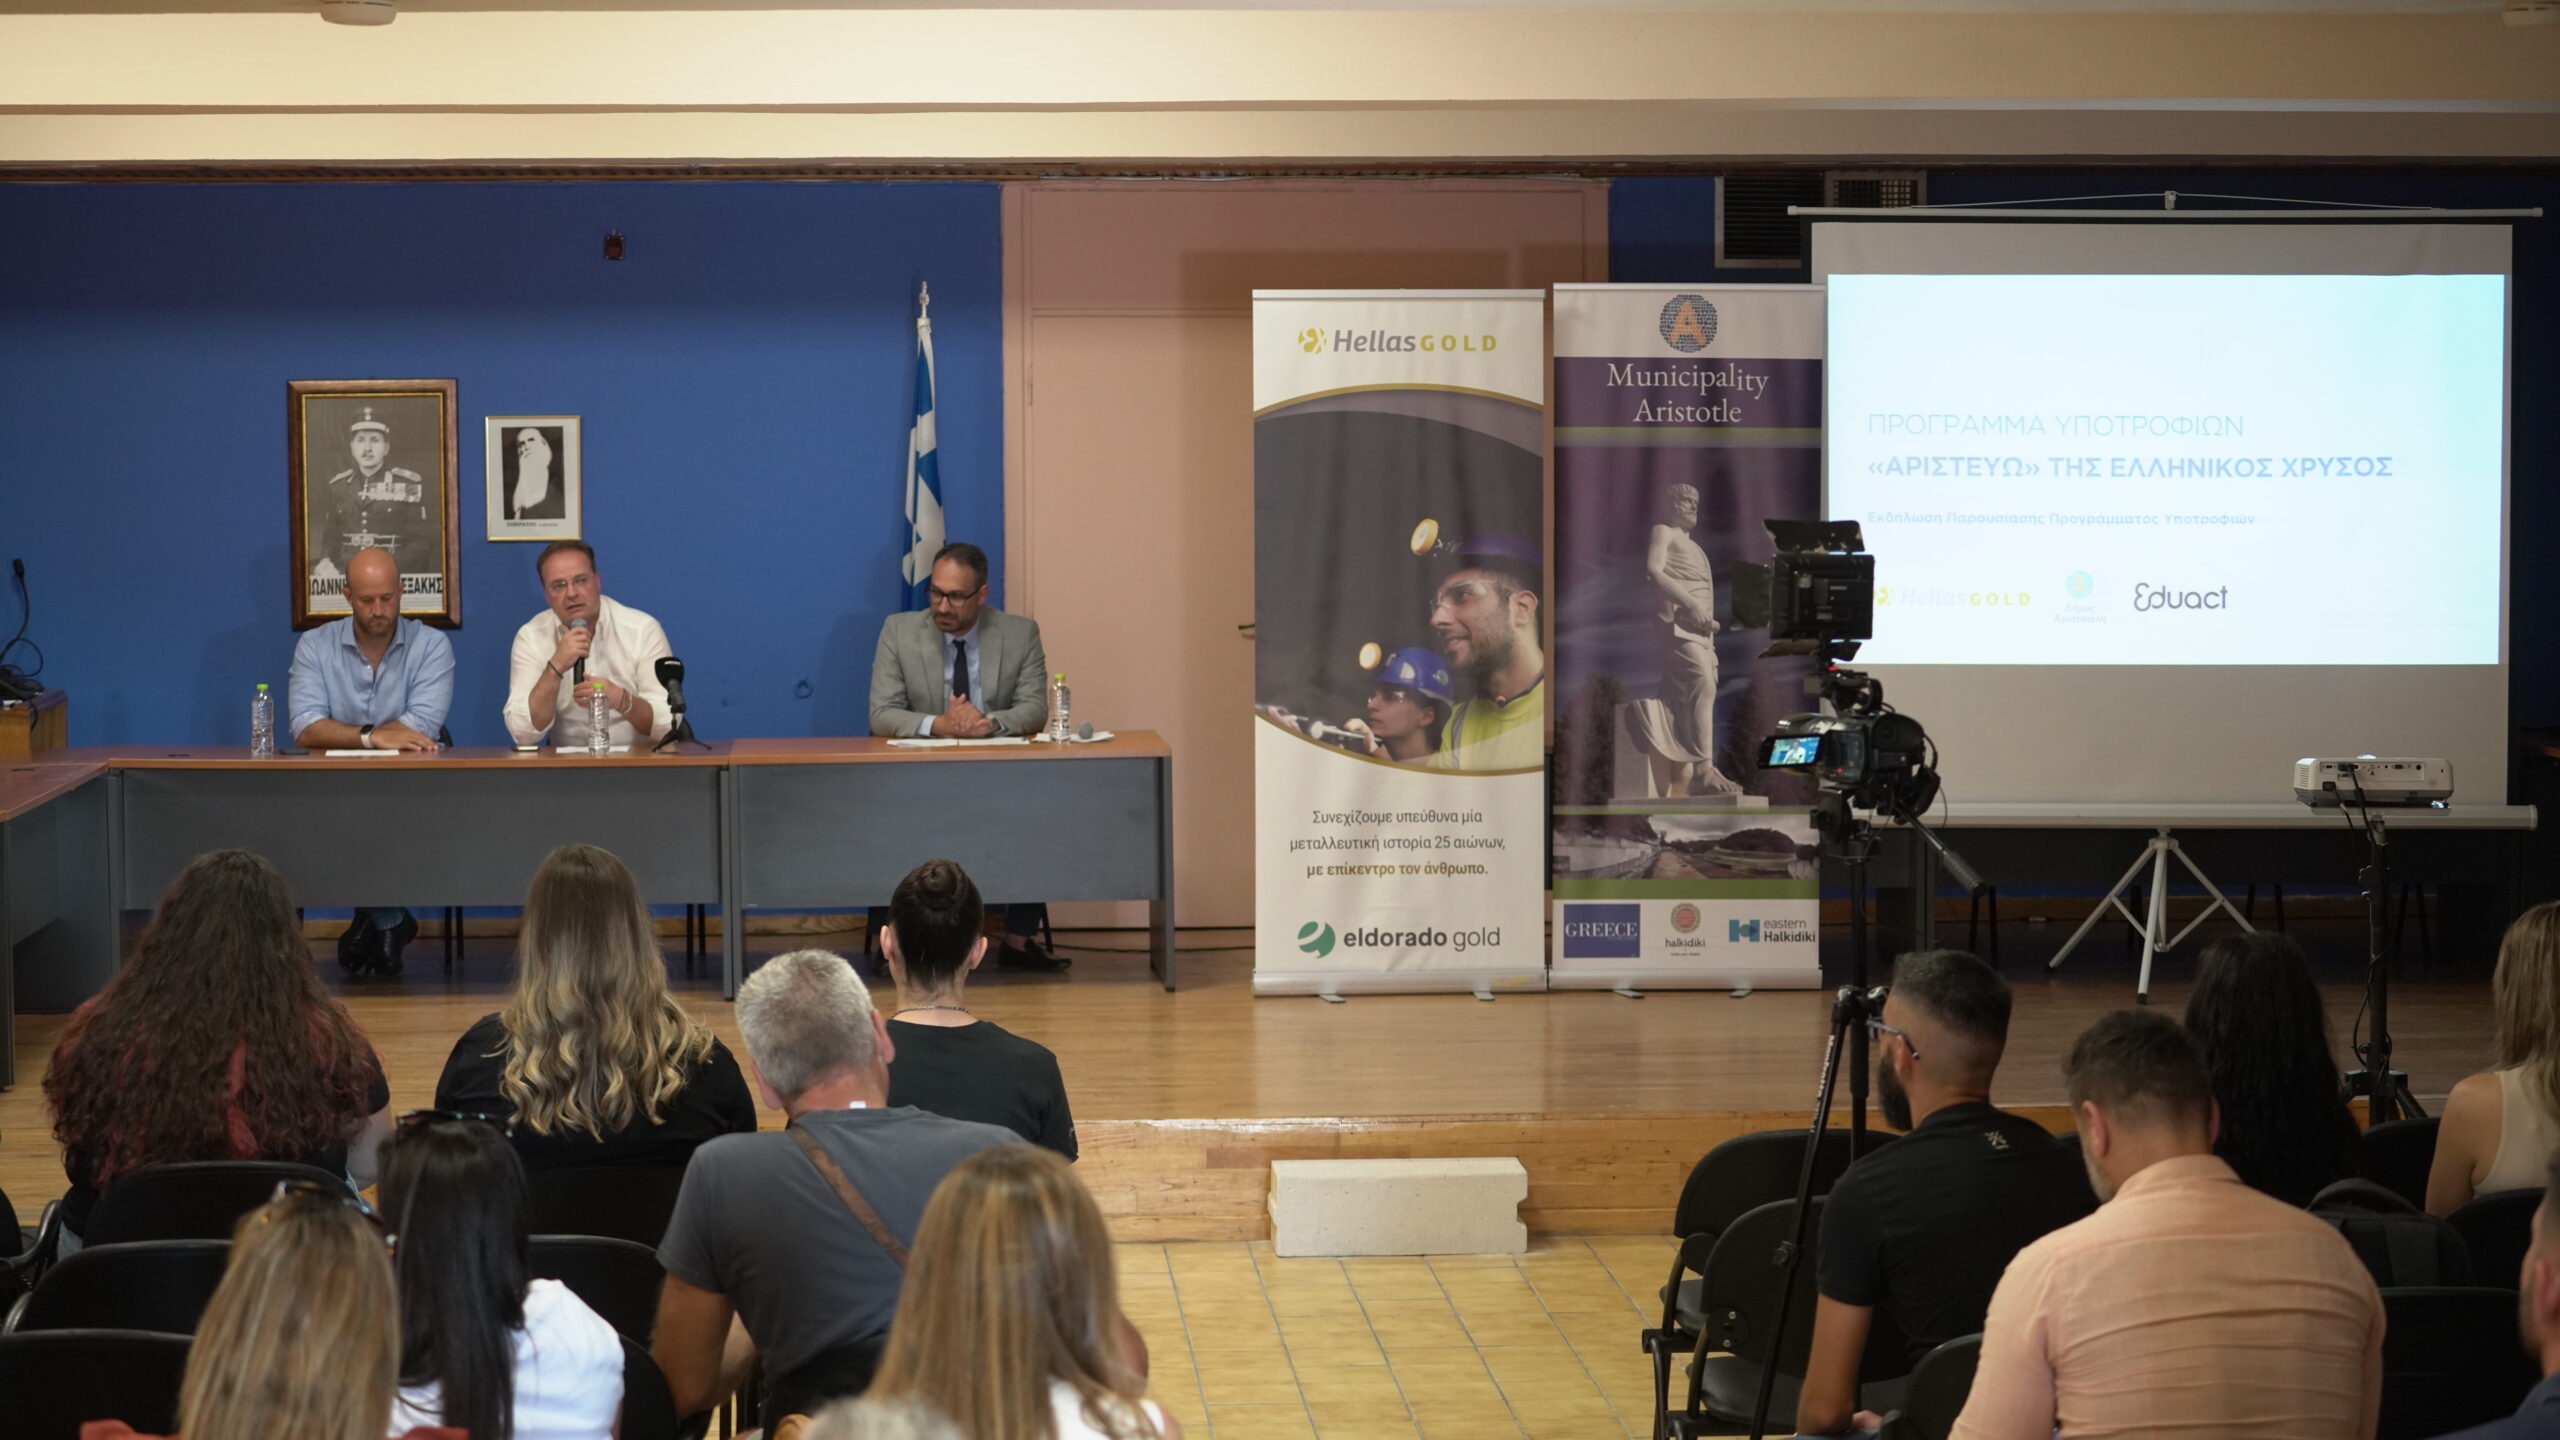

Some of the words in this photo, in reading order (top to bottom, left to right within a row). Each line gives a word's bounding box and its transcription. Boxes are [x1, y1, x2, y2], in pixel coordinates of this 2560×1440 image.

[1606, 362, 1769, 400] Municipality
[1632, 397, 1742, 423] Aristotle
[1867, 413, 2047, 436] ΠΡΟΓΡΑΜΜΑ
[2055, 414, 2244, 437] ΥΠΟΤΡΟΦΙΩΝ
[1867, 455, 2040, 478] «ΑΡΙΣΤΕΥΩ»
[2048, 456, 2102, 478] ΤΗΣ
[2110, 456, 2273, 479] ΕΛΛΗΝΙΚΟΣ
[2281, 456, 2393, 478] ΧΡΥΣΟΣ
[400, 577, 443, 594] ΕΞΑΚΗΣ
[2133, 582, 2229, 612] Eduact
[1312, 810, 1393, 827] Συνεχίζουμε
[1396, 808, 1459, 825] υπεύθυνα
[1461, 808, 1483, 826] μία
[1289, 836, 1380, 853] μεταλλευτική
[1383, 835, 1432, 852] ιστορία
[1434, 836, 1451, 850] 25
[1453, 835, 1506, 851] αιώνων,
[1306, 864, 1325, 878] με
[1327, 861, 1396, 877] επίκεντρο
[1398, 864, 1421, 875] τον
[1423, 861, 1489, 878] άνθρωπο.
[1565, 922, 1638, 938] GREECE
[1763, 918, 1807, 929] eastern
[1343, 927, 1448, 948] eldorado
[1452, 926, 1501, 953] gold
[1665, 937, 1706, 949] halkidiki
[1763, 930, 1816, 944] Halkidiki
